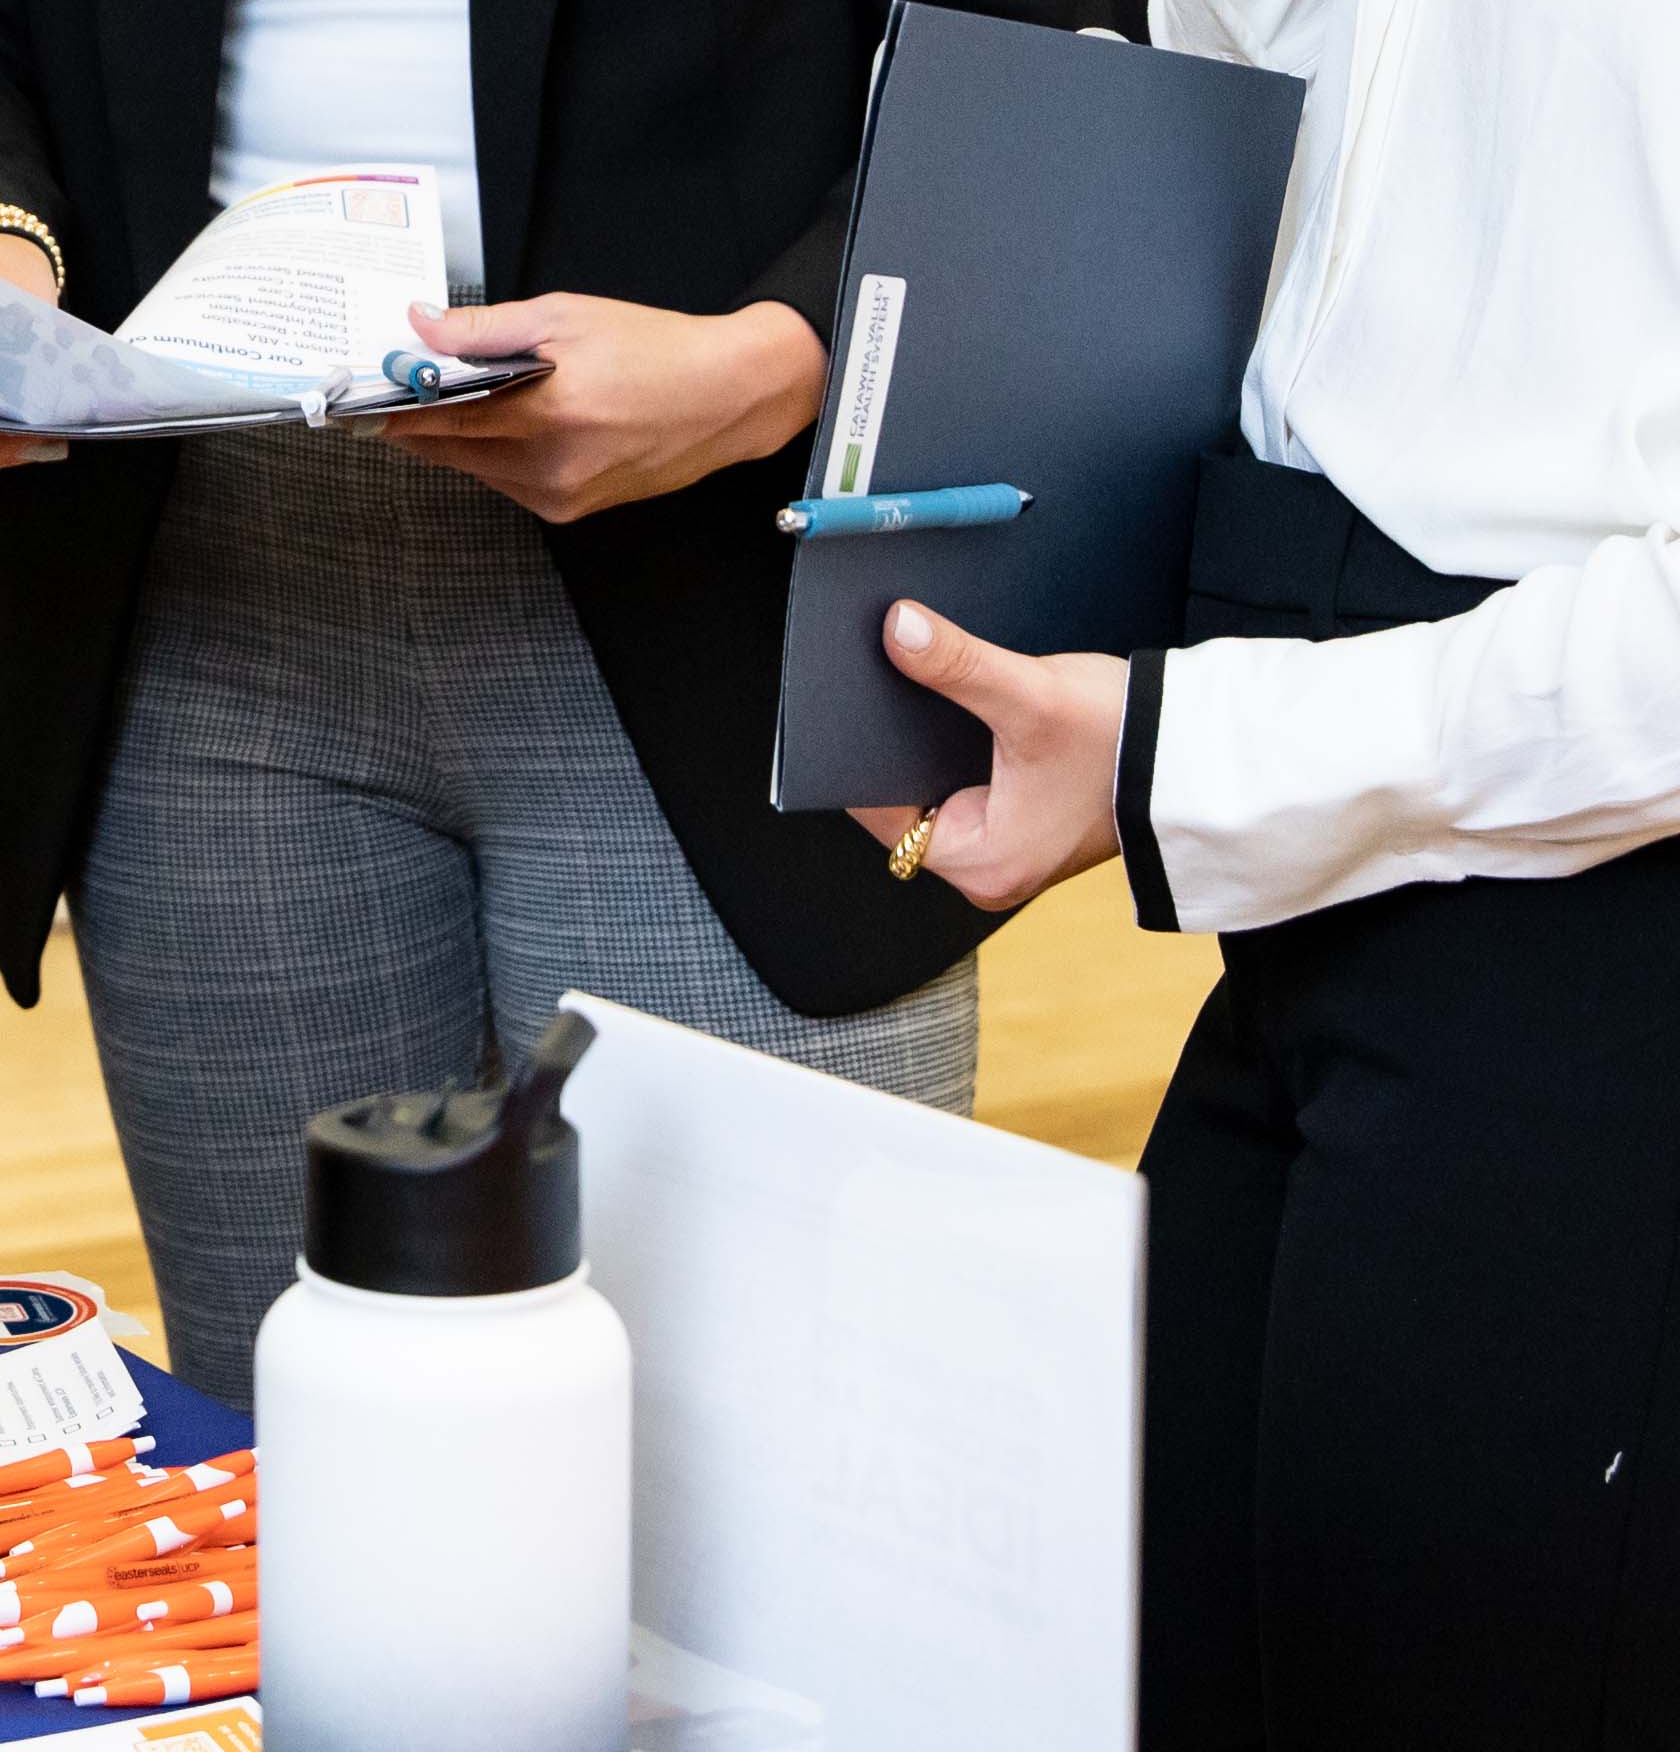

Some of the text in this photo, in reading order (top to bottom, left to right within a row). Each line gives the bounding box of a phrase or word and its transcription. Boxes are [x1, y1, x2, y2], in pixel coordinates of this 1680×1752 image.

[249, 297, 346, 321] Employment
[257, 287, 346, 309] Foster Care
[209, 303, 348, 335] Early Intervention
[867, 281, 884, 344] VALLEY
[202, 313, 349, 345] Camp Recreation
[154, 335, 262, 361] Continuum
[267, 353, 303, 367] Our
[296, 342, 350, 356] Autism
[857, 296, 889, 438] HEALTH SYSTEM
[114, 1564, 177, 1581] easterseals
